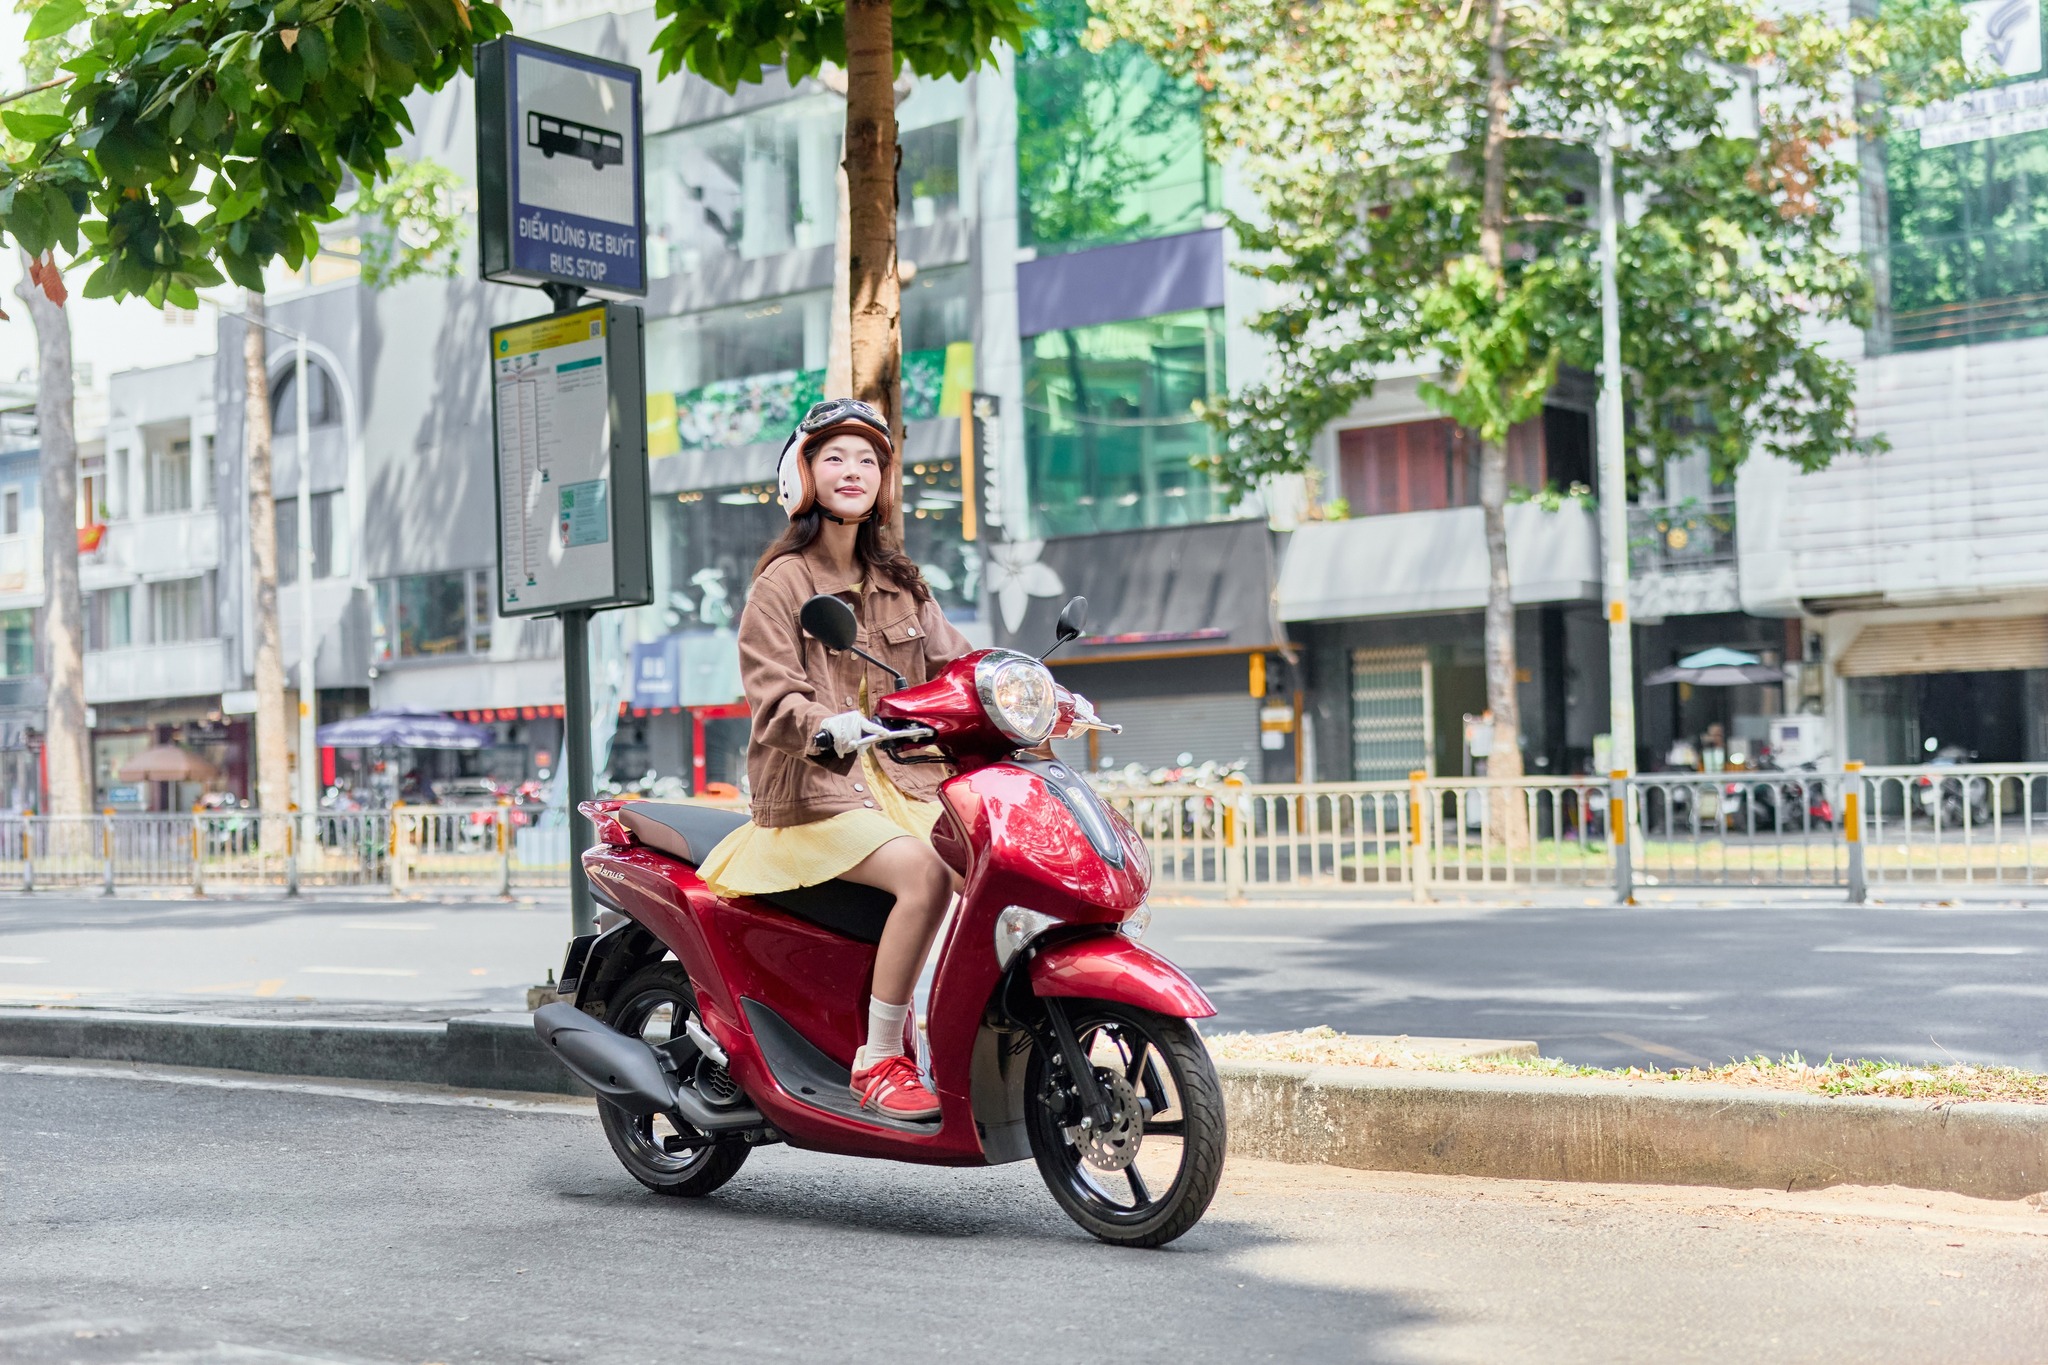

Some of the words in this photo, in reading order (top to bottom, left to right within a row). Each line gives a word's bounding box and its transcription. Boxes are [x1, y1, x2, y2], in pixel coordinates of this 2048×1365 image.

[519, 212, 549, 242] ĐIỂM
[588, 231, 603, 253] XE
[605, 233, 636, 258] BUÝT
[550, 253, 573, 275] BUS
[577, 258, 607, 281] STOP
